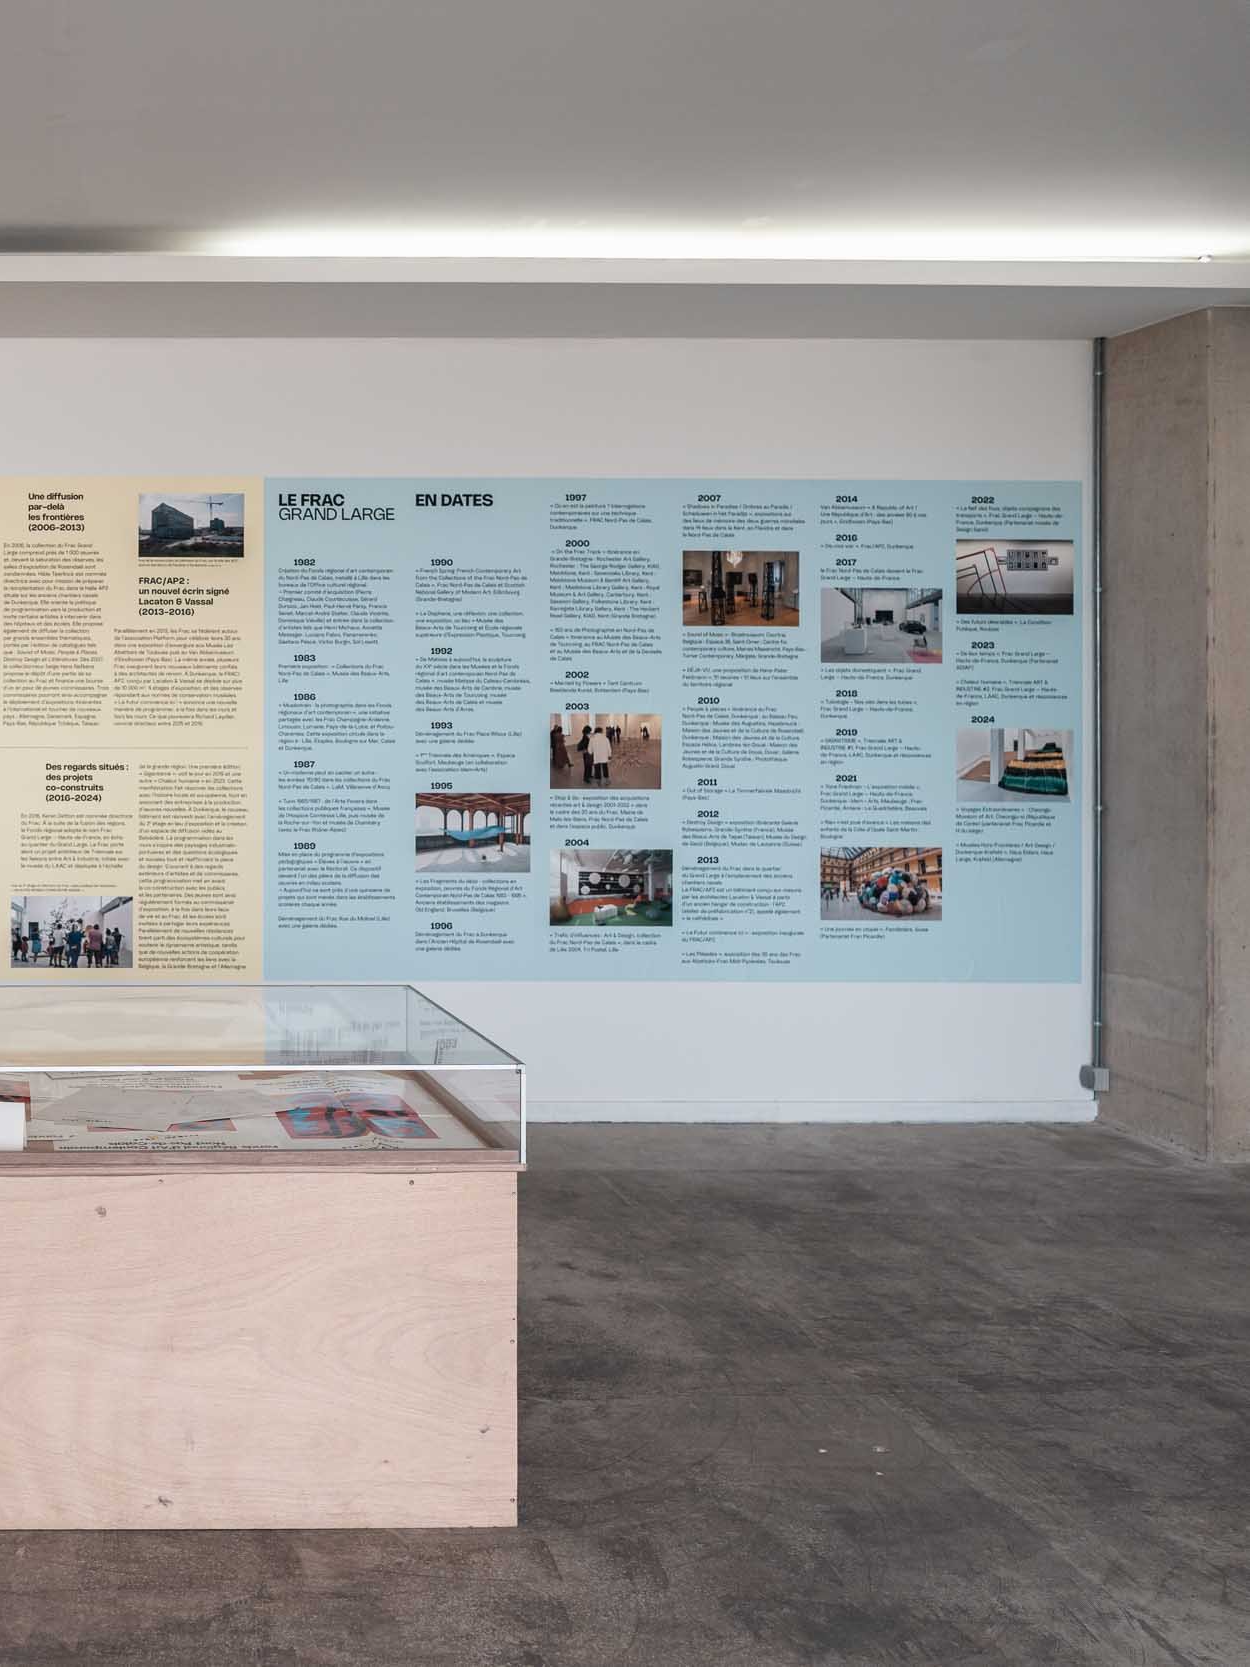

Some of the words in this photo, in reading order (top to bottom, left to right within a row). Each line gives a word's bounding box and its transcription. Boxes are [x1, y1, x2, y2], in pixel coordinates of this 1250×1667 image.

[28, 492, 45, 501] Une
[46, 492, 84, 501] diffusion
[278, 493, 298, 507] LE
[300, 493, 345, 507] FRAC
[415, 493, 438, 507] EN
[440, 493, 494, 507] DATES
[565, 493, 587, 502] 1997
[697, 494, 722, 503] 2007
[835, 495, 858, 503] 2014
[971, 495, 995, 505] 2022
[27, 502, 65, 513] par-delà
[27, 513, 41, 521] les
[42, 512, 85, 521] frontières
[278, 507, 338, 521] GRAND
[341, 507, 396, 521] LARGE
[835, 533, 858, 542] 2016
[565, 539, 591, 548] 2000
[293, 558, 316, 567] 1982
[430, 558, 454, 567] 1990
[835, 558, 857, 567] 2017
[151, 587, 181, 596] nouvel
[181, 586, 205, 596] écrin
[205, 587, 230, 597] signé
[138, 597, 174, 606] Lacaton
[184, 597, 214, 606] Vassal
[971, 641, 995, 650] 2023
[430, 647, 453, 655] 1992
[293, 654, 317, 662] 1983
[565, 670, 590, 679] 2002
[293, 693, 317, 701] 1986
[835, 689, 858, 698] 2018
[697, 696, 720, 705] 2010
[565, 702, 590, 711] 2003
[970, 715, 996, 724] 2024
[430, 721, 453, 730] 1993
[835, 728, 858, 737] 2019
[45, 762, 63, 771] Des
[63, 762, 98, 773] regards
[98, 763, 125, 771] situés
[293, 760, 316, 769] 1987
[45, 773, 62, 781] des
[62, 773, 94, 783] projets
[697, 778, 718, 787] 2011
[835, 774, 858, 783] 2021
[45, 783, 105, 792] co-construits
[430, 781, 453, 790] 1995
[697, 809, 720, 818] 2012
[293, 842, 317, 850] 1989
[564, 838, 590, 847] 2004
[696, 856, 719, 864] 2013
[430, 922, 453, 930] 1996
